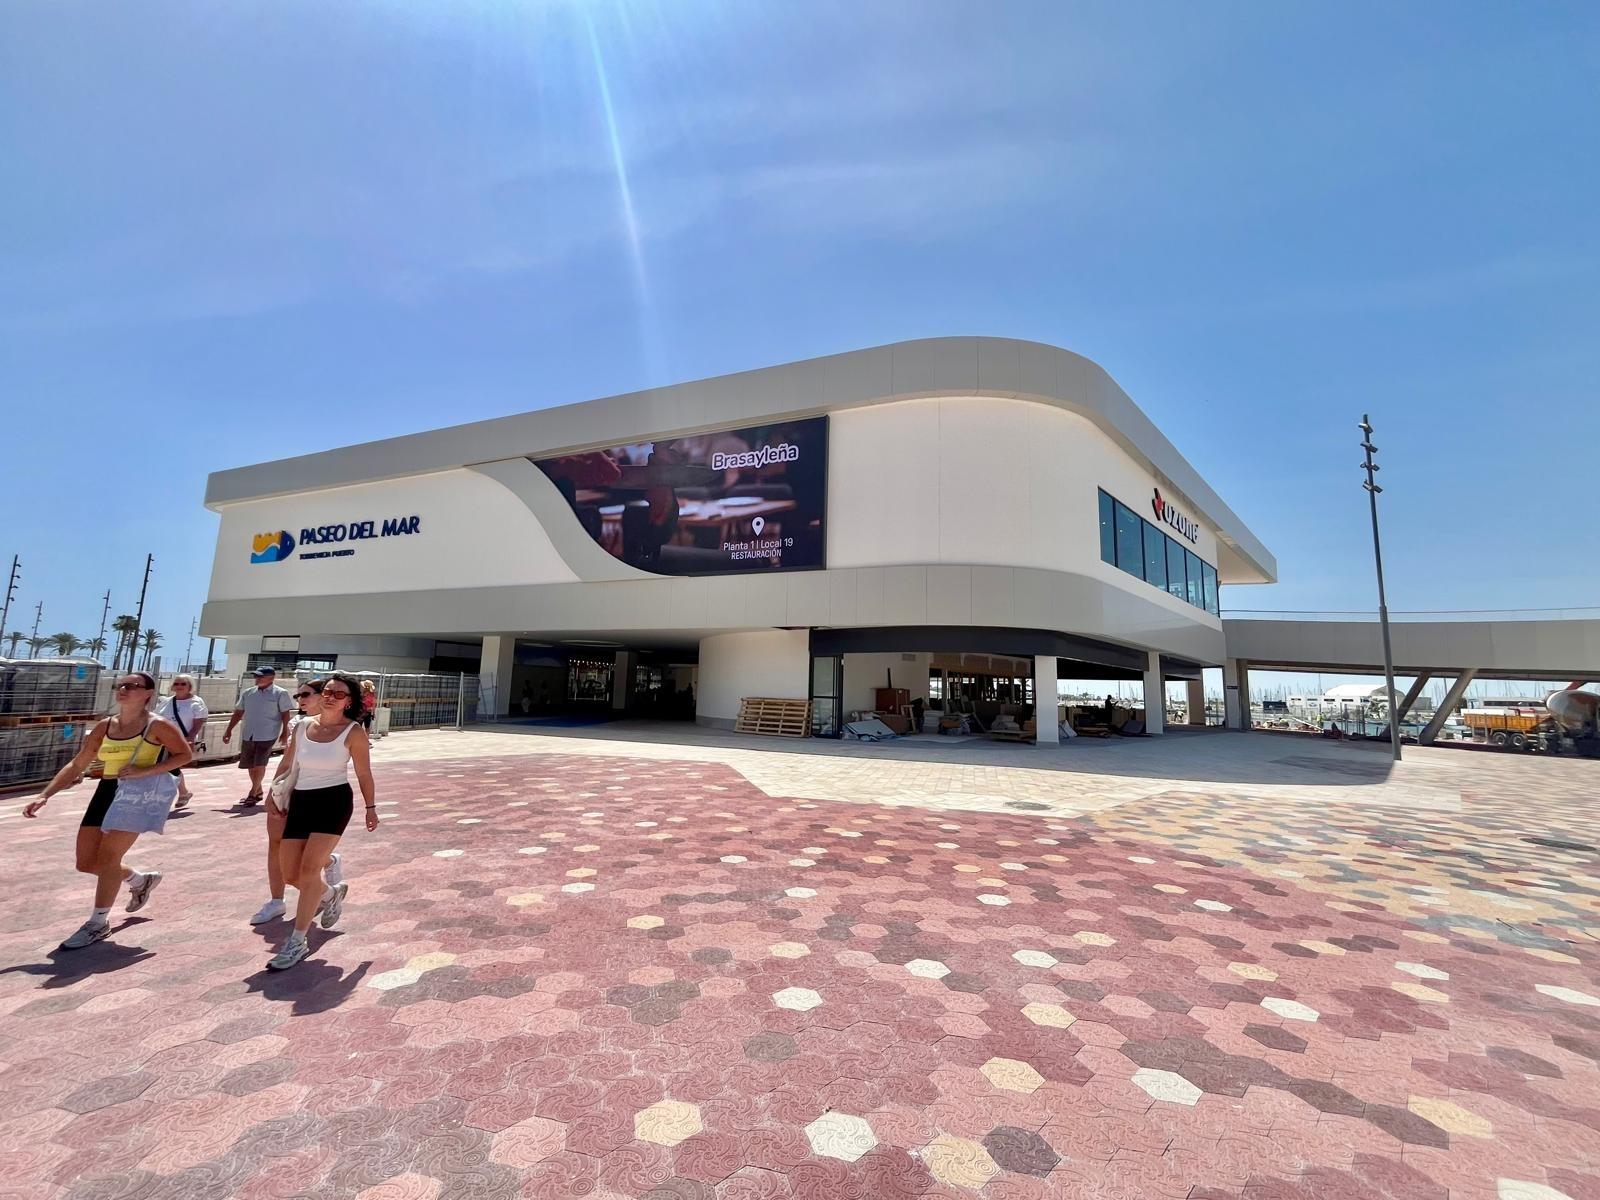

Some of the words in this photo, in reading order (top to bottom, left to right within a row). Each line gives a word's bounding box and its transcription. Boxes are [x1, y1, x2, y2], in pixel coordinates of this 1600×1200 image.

[712, 443, 799, 470] Brasayleña
[300, 524, 346, 545] PASEO
[348, 521, 378, 540] DEL
[381, 516, 420, 537] MAR
[723, 541, 749, 551] Planta
[760, 538, 782, 549] Local
[784, 537, 794, 547] 19
[731, 549, 782, 560] RESTAURACIÓN
